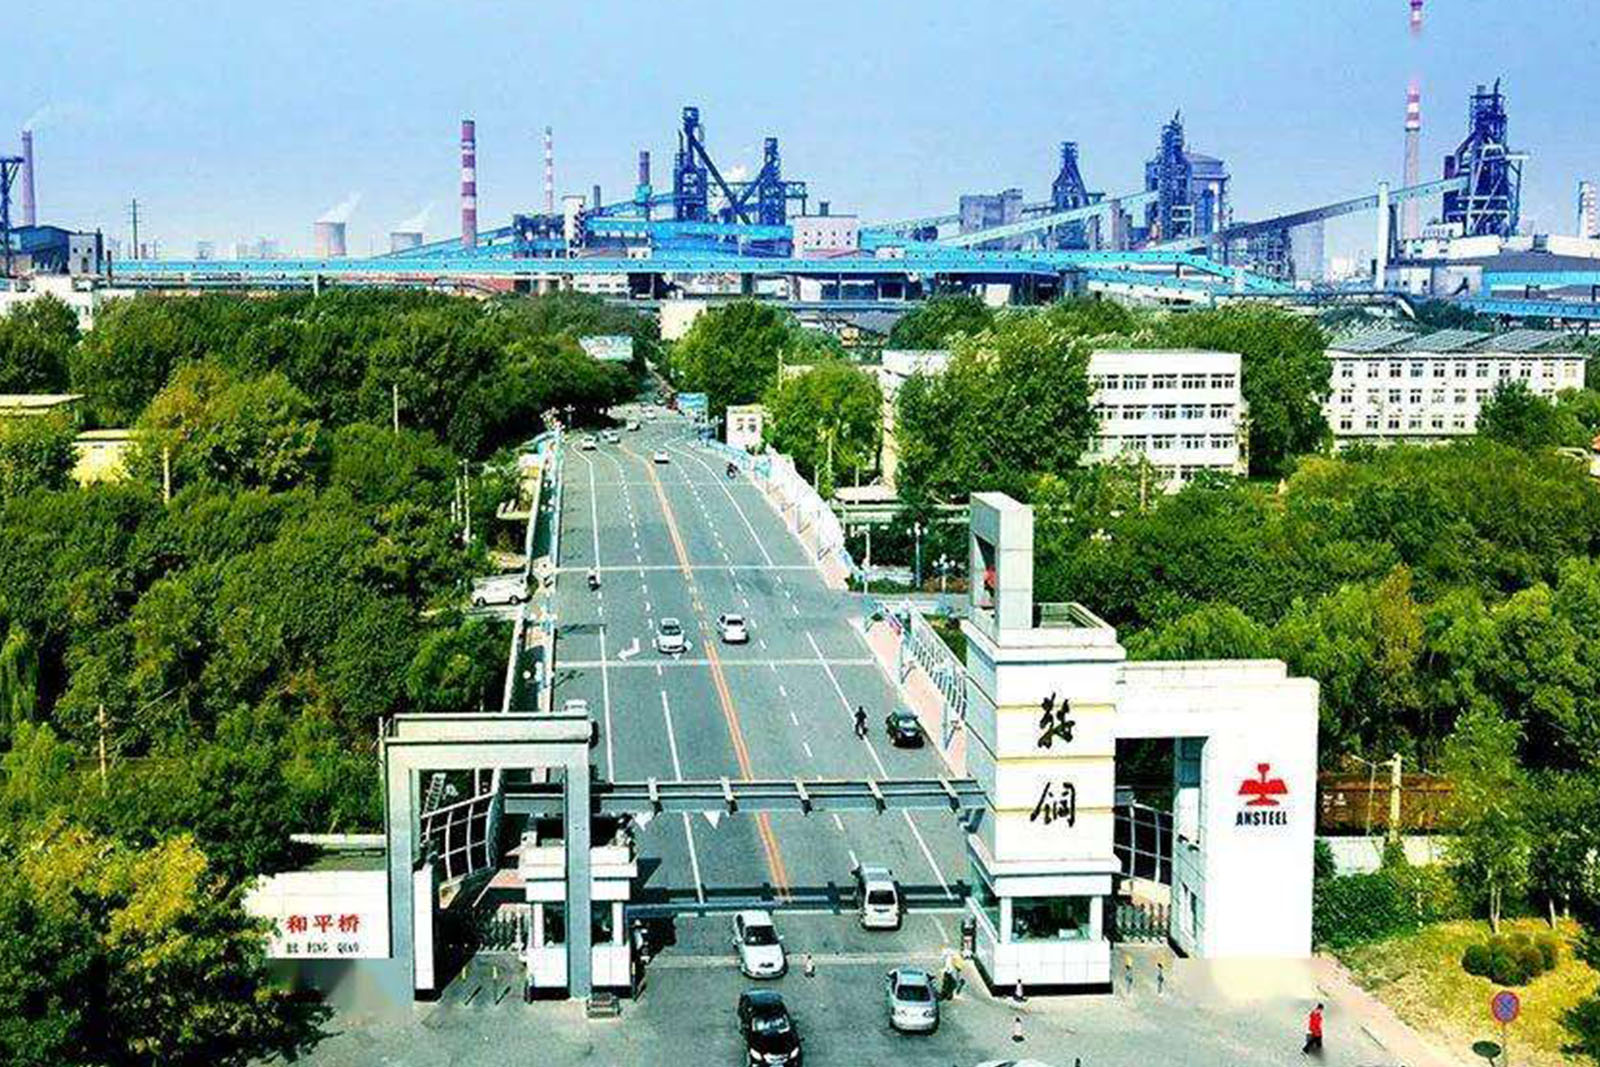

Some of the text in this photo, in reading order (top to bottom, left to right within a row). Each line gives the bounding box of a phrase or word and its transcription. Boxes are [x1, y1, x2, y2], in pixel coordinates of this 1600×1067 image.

[1235, 810, 1288, 826] ANSTEEL
[286, 913, 360, 933] 和平桥
